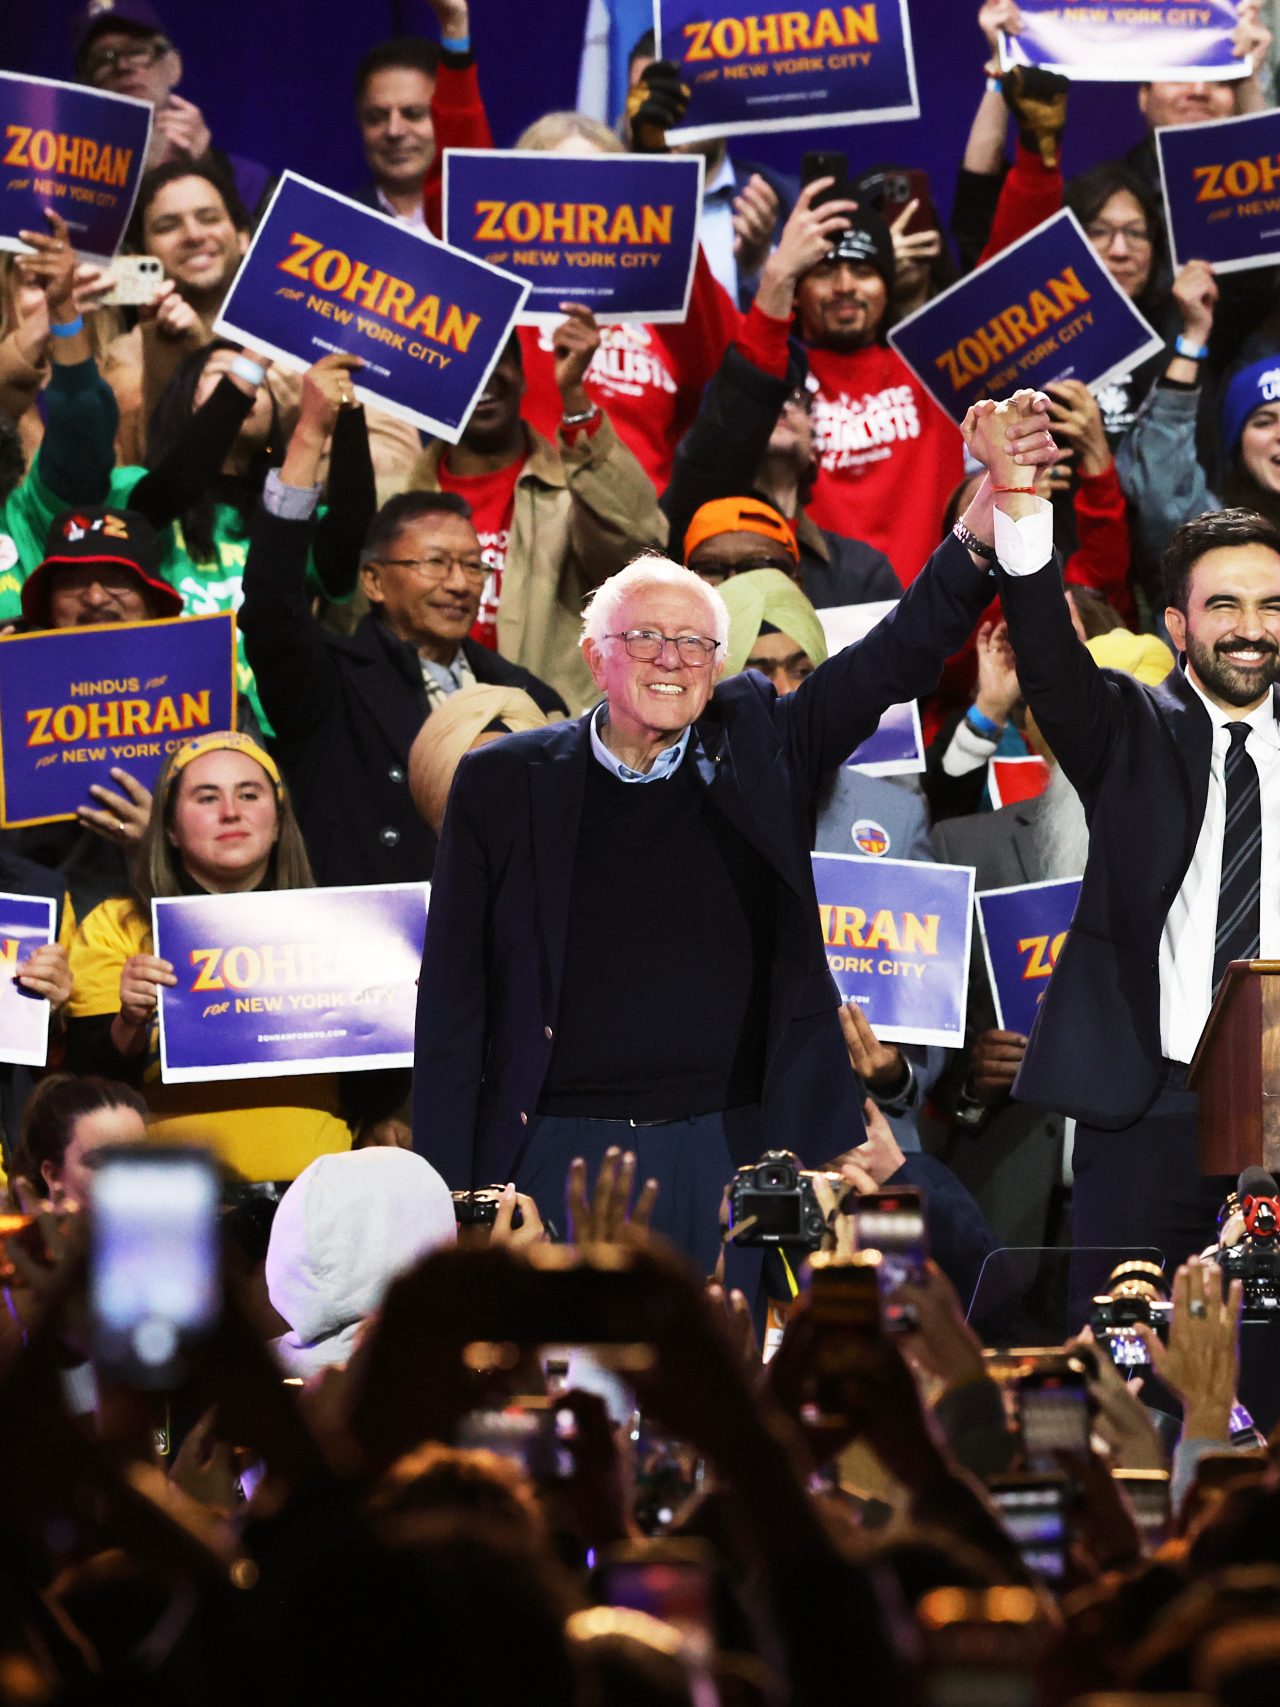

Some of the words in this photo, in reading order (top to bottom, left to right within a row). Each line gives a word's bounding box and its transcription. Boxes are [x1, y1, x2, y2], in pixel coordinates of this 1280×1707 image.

[683, 3, 879, 62] ZOHRAN
[723, 63, 769, 80] NEW
[773, 57, 824, 75] YORK
[827, 52, 872, 70] CITY
[2, 124, 133, 188] ZOHRAN
[473, 200, 674, 245] ZOHRAN
[513, 250, 560, 267] NEW
[565, 251, 616, 267] YORK
[620, 252, 661, 268] CITY
[276, 232, 481, 354] ZOHRAN
[306, 294, 354, 326] NEW
[356, 316, 407, 351] YORK
[408, 341, 452, 370] CITY
[934, 265, 1092, 392] ZOHRAN
[70, 677, 141, 697] HINDUS
[25, 690, 211, 747] ZOHRAN
[62, 748, 107, 764] NEW
[111, 743, 161, 759] YORK
[878, 958, 927, 978] CITY
[203, 1002, 230, 1019] FOR
[235, 997, 284, 1014] NEW
[288, 992, 344, 1011] YORK
[350, 988, 396, 1006] CITY
